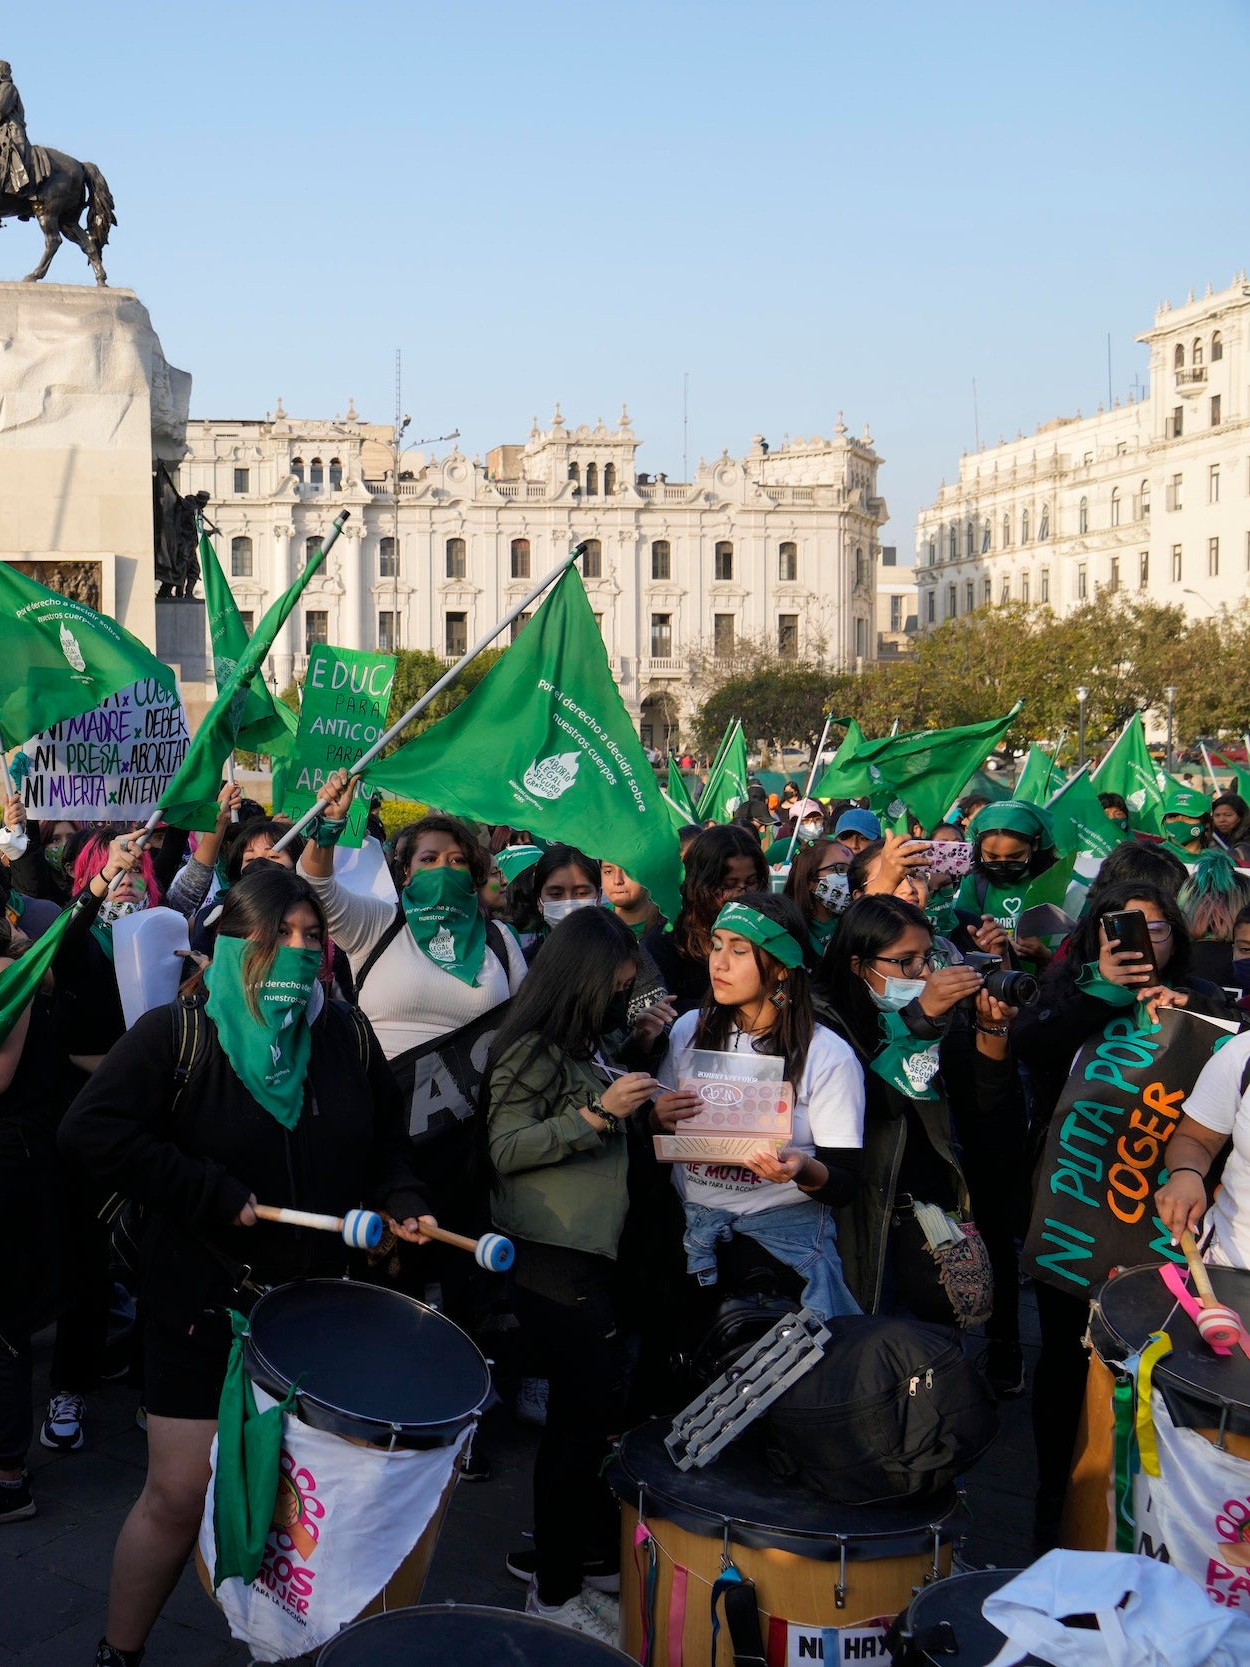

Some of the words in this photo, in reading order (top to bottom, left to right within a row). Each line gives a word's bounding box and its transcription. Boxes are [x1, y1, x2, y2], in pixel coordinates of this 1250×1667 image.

[31, 598, 61, 610] derecho
[70, 603, 100, 621] decidir
[99, 620, 121, 640] sobre
[37, 612, 63, 623] nuestros
[335, 695, 380, 718] PARA
[66, 710, 133, 744] MADRE
[145, 705, 188, 740] DEBER
[34, 743, 56, 772] NI
[66, 743, 122, 775] PRESA
[326, 744, 364, 763] PARA
[538, 678, 555, 692] Por
[554, 690, 564, 701] el
[562, 697, 601, 734] derecho
[600, 732, 609, 742] a
[606, 740, 633, 777] decidir
[627, 779, 646, 812] sobre
[552, 713, 590, 749] nuestros
[587, 748, 618, 786] cuerpos
[534, 769, 561, 794] SEGURO
[539, 763, 561, 786] LEGAL
[548, 757, 572, 782] ABORTO
[24, 774, 44, 808] NI
[49, 774, 108, 808] MUERTA
[117, 774, 175, 807] INTENT
[419, 914, 445, 922] nuestros
[265, 980, 302, 991] derecho
[1084, 1016, 1163, 1095] POR
[1050, 1100, 1126, 1209] PUTA
[1106, 1081, 1186, 1224] COGER
[704, 1165, 763, 1184] MUJER
[708, 1178, 724, 1189] PARA
[724, 1181, 734, 1191] LA
[1035, 1217, 1096, 1287] NI
[252, 1582, 270, 1600] PARA
[271, 1596, 280, 1607] LA
[282, 1604, 308, 1628] ACCIÓN
